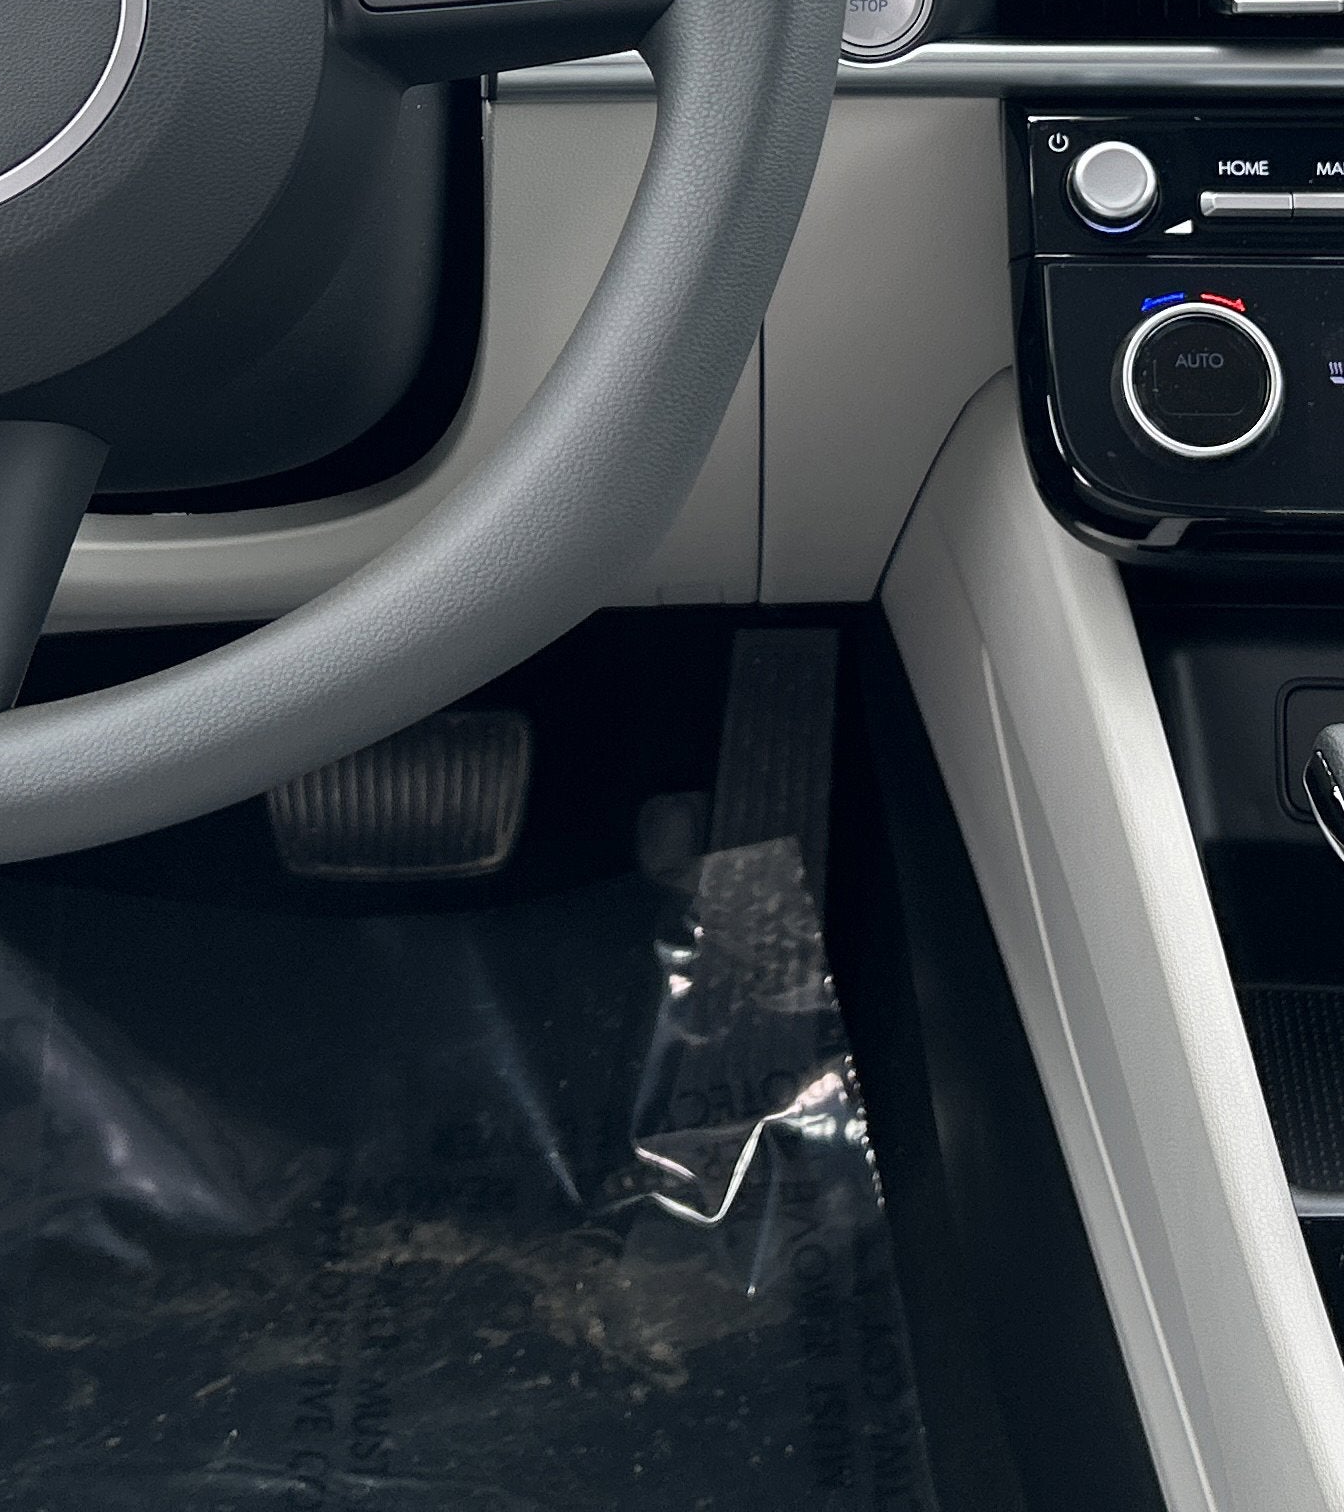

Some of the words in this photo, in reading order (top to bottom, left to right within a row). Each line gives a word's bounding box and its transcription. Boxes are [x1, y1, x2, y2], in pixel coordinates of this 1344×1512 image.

[849, 0, 888, 12] STOP
[1218, 161, 1270, 176] HOME
[1175, 353, 1224, 369] AUTO
